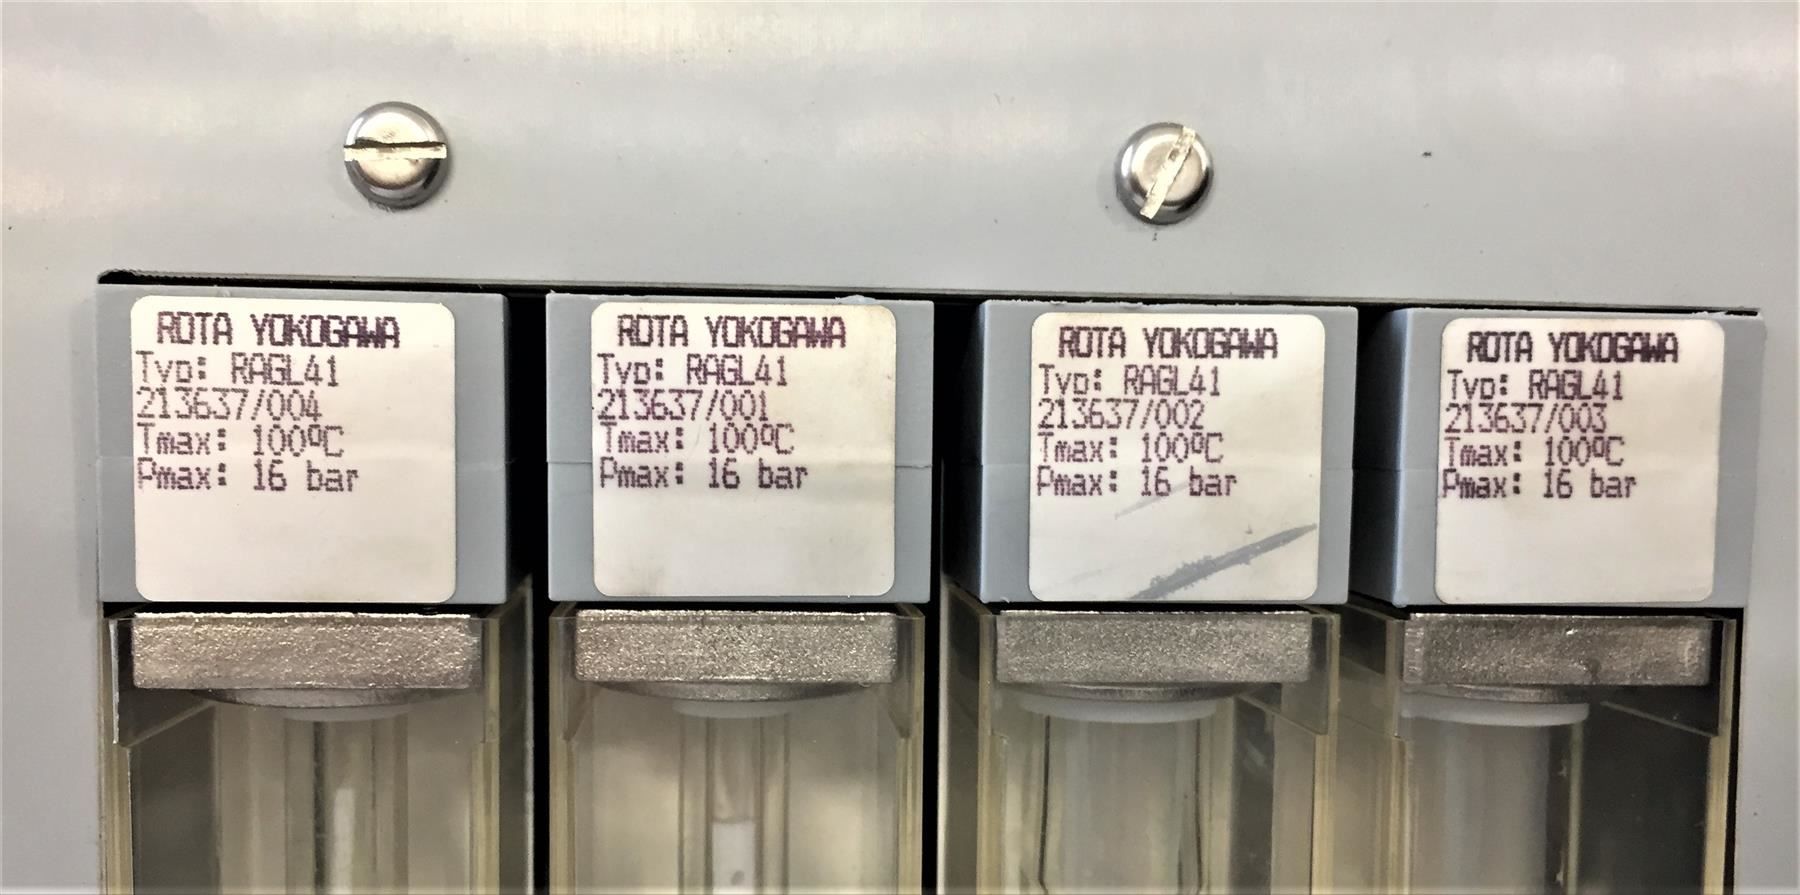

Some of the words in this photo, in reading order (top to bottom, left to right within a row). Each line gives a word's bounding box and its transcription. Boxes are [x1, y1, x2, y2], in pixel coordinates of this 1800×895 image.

[157, 311, 233, 345] ROTA
[250, 313, 400, 349] YOKOGAWA
[617, 314, 688, 347] ROTA
[705, 315, 846, 348] YOKOGAWA
[1058, 326, 1127, 358] ROTA
[1142, 327, 1279, 359] YOKOGAWA
[1467, 331, 1533, 362] ROTA
[1548, 332, 1679, 363] YOKOGAWA
[231, 352, 339, 387] RAGL41
[686, 353, 787, 386] RAGL41
[1123, 364, 1220, 396] RAGL41
[1528, 370, 1623, 400] RAGL41
[137, 386, 322, 422] 213637/004
[597, 388, 768, 421] 213637/001
[1038, 398, 1205, 430] 213637/002
[1444, 403, 1607, 433] 213637/003
[137, 422, 227, 455] Tmax:
[600, 421, 684, 453] Tmax:
[1038, 431, 1117, 462] Tmax:
[1444, 436, 1521, 467] Tmax:
[138, 457, 227, 491] Pmax:
[253, 459, 287, 492] 16
[306, 460, 358, 492] bar
[600, 456, 684, 488] Pmax:
[708, 457, 740, 489] 16
[758, 458, 808, 489] bar
[1037, 465, 1117, 496] Pmax:
[1141, 465, 1171, 497] 16
[1189, 466, 1238, 497] bar
[1442, 468, 1520, 498] Pmax:
[1543, 468, 1572, 498] 16
[1590, 468, 1637, 498] bar
